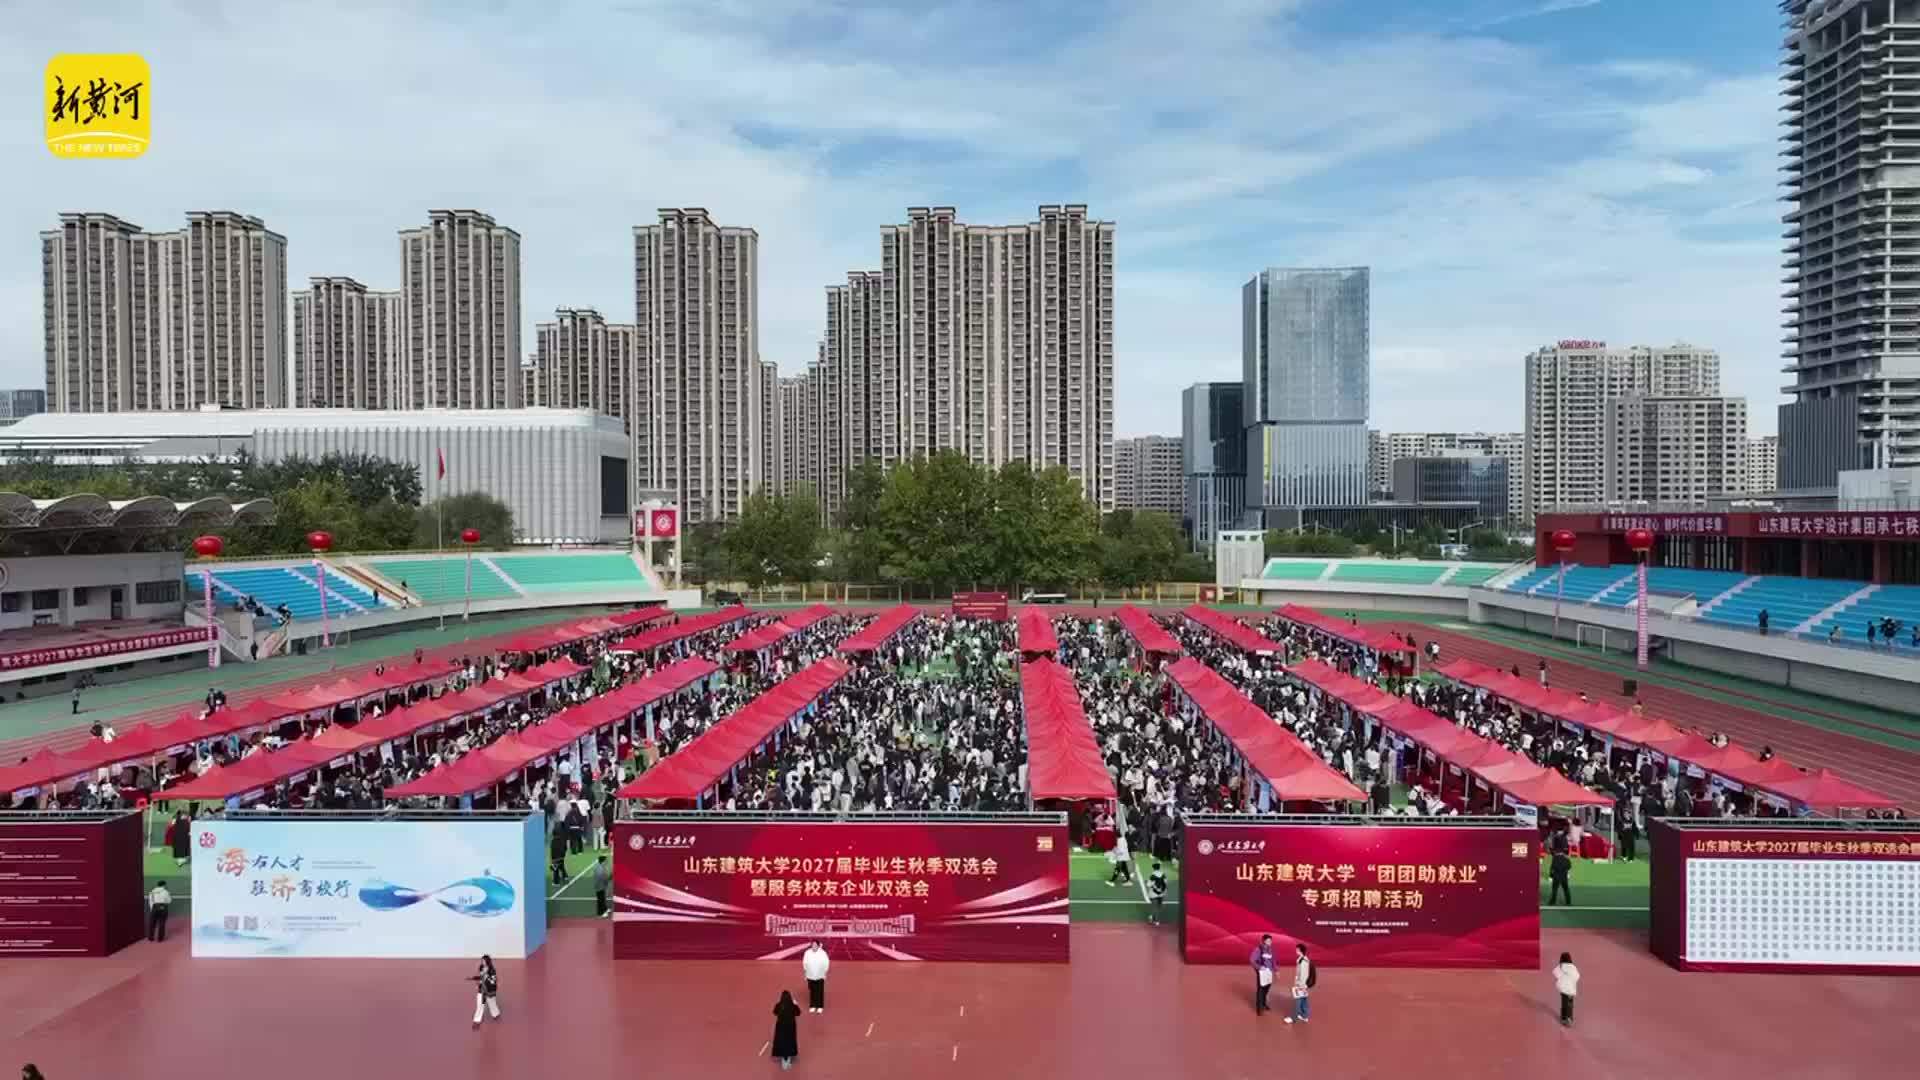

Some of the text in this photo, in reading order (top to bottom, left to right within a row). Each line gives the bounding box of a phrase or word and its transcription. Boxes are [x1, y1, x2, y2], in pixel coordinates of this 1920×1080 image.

[216, 848, 305, 877] 海右人才
[683, 855, 999, 876] 山东建筑大学2027届毕业生秋季双选会
[250, 875, 352, 902] 驻济高校行
[750, 879, 931, 899] 暨服务校友企业双选会
[1301, 889, 1425, 909] 专项招聘活动
